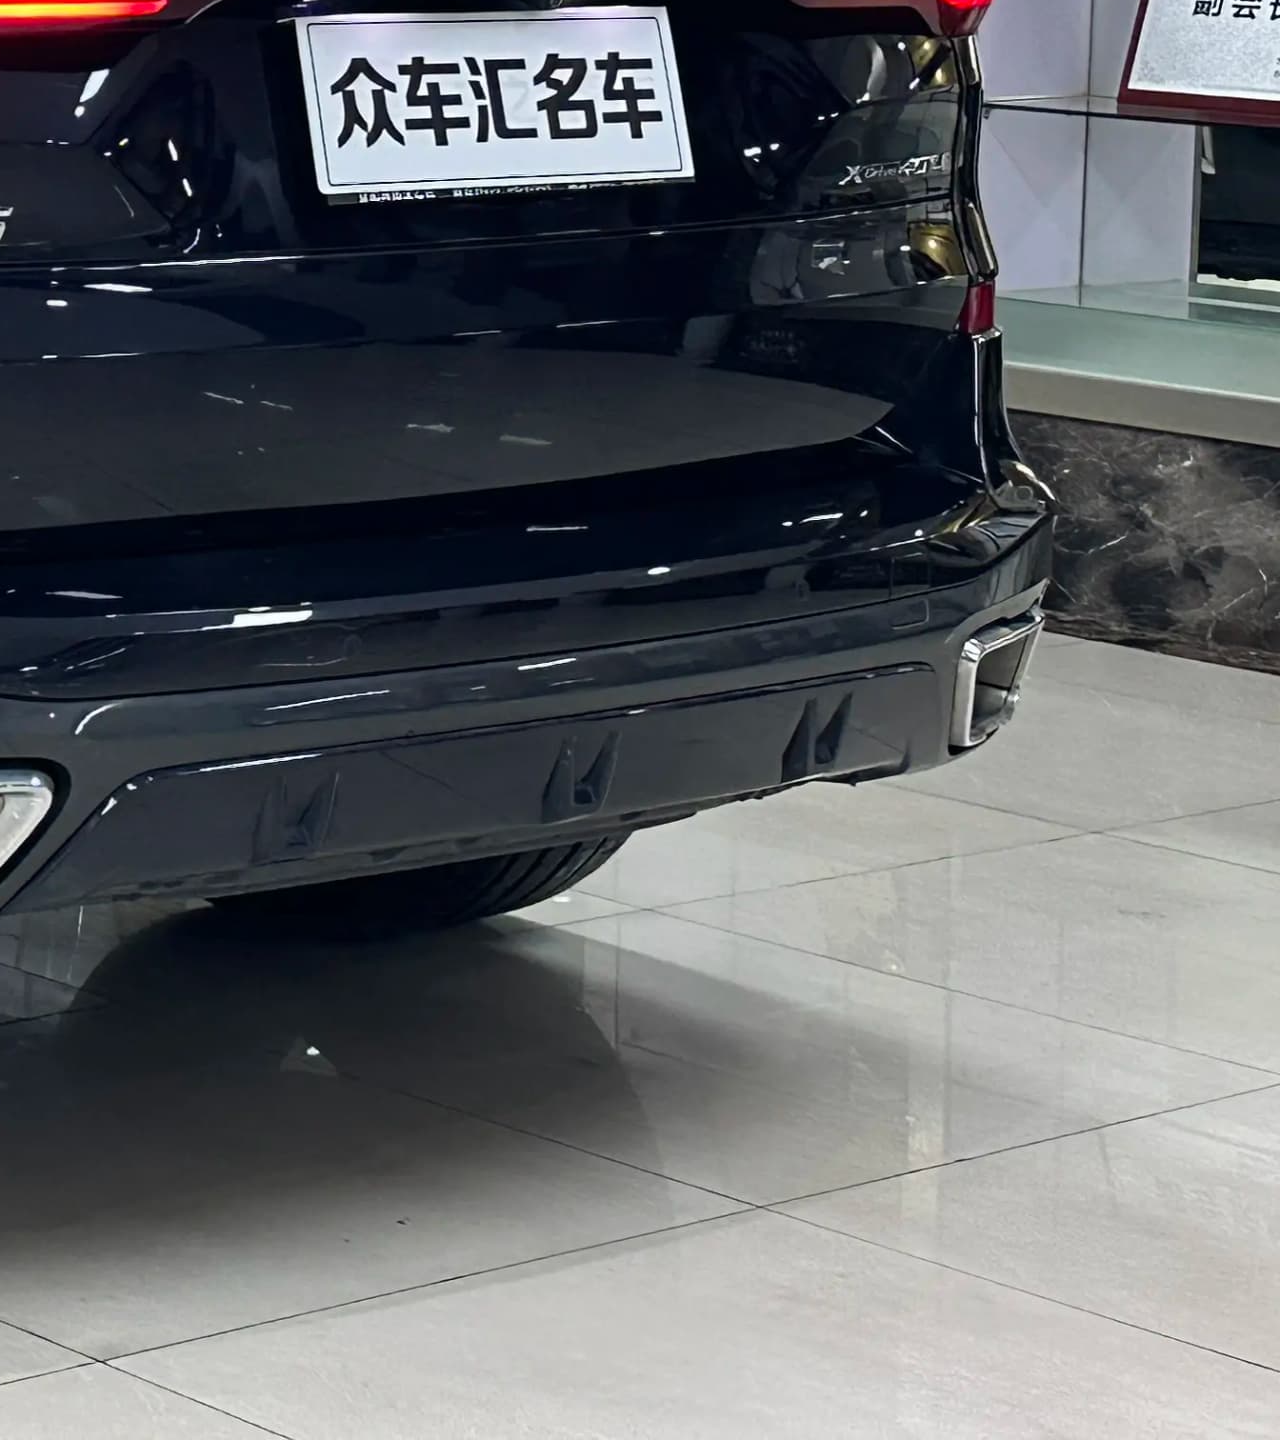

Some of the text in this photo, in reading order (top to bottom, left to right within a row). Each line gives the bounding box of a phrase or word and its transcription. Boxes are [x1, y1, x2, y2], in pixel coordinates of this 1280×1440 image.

[330, 51, 663, 148] 众车汇名车
